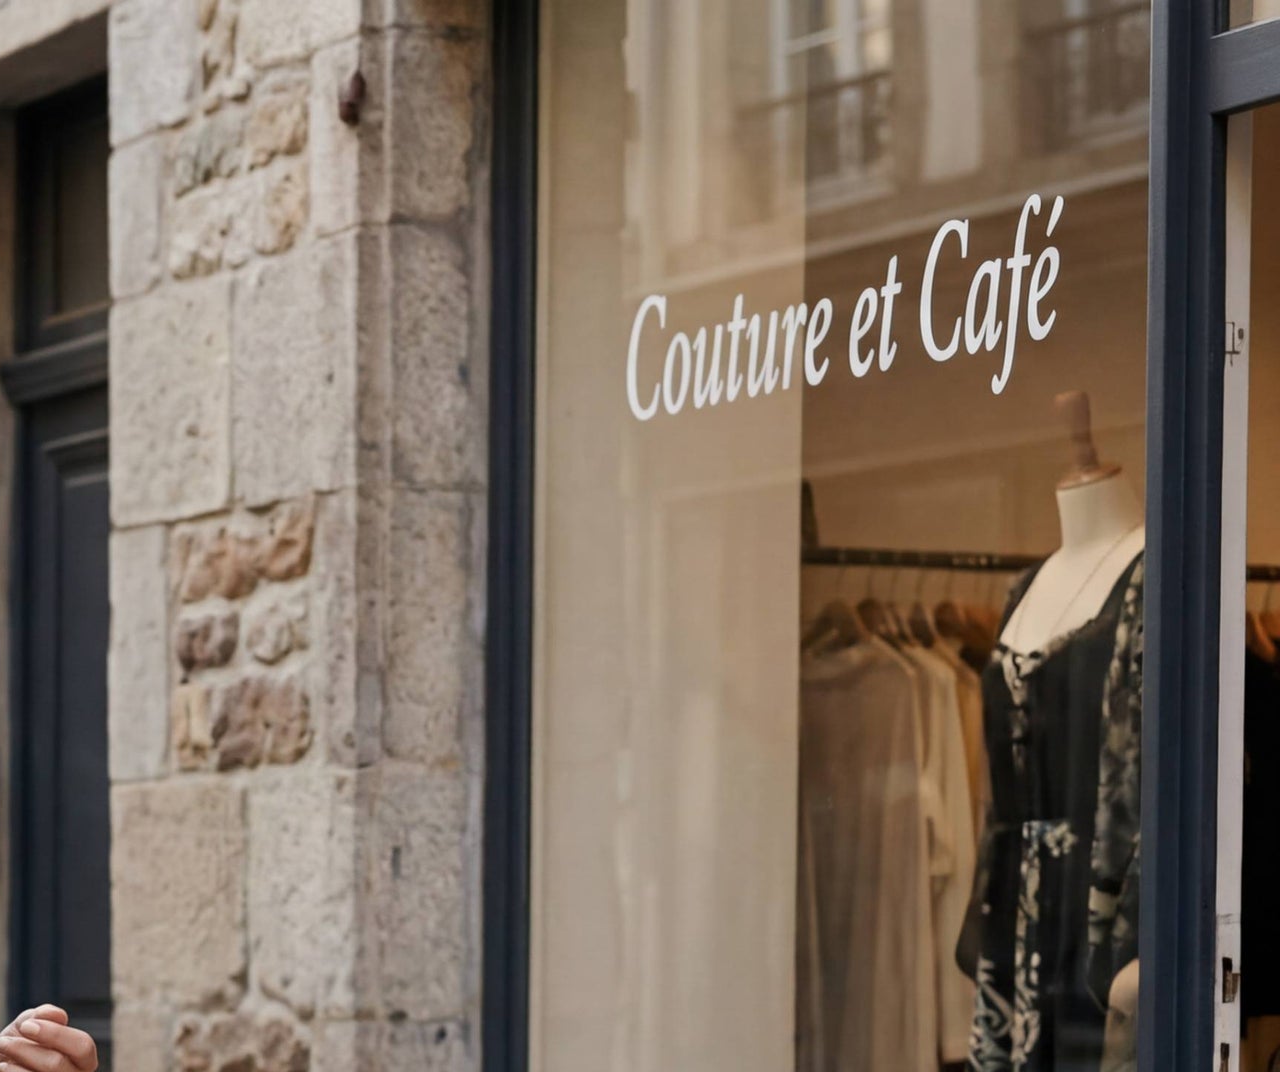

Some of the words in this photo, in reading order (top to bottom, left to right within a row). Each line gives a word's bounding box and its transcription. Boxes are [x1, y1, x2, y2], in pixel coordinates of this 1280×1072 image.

[626, 293, 833, 420] Couture
[849, 256, 902, 377] et
[920, 194, 1064, 394] Café
